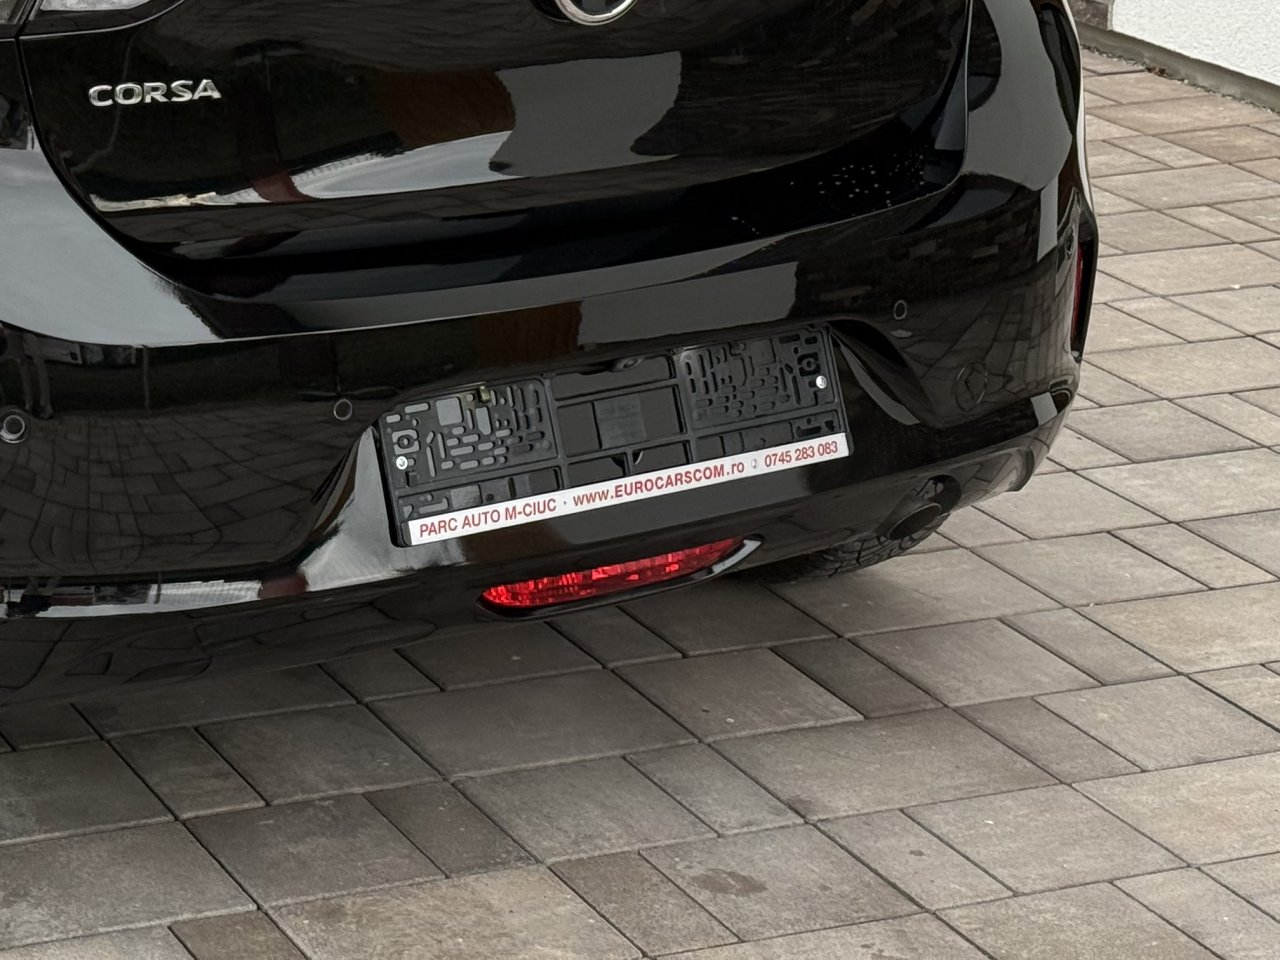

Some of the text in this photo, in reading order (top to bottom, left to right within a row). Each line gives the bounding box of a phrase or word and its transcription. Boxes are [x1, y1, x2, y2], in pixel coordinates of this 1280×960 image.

[88, 78, 222, 107] CORSA
[419, 440, 839, 538] PARC AUTO M-CIUC www.EUROCARSCOM.ro 0745 283 083
